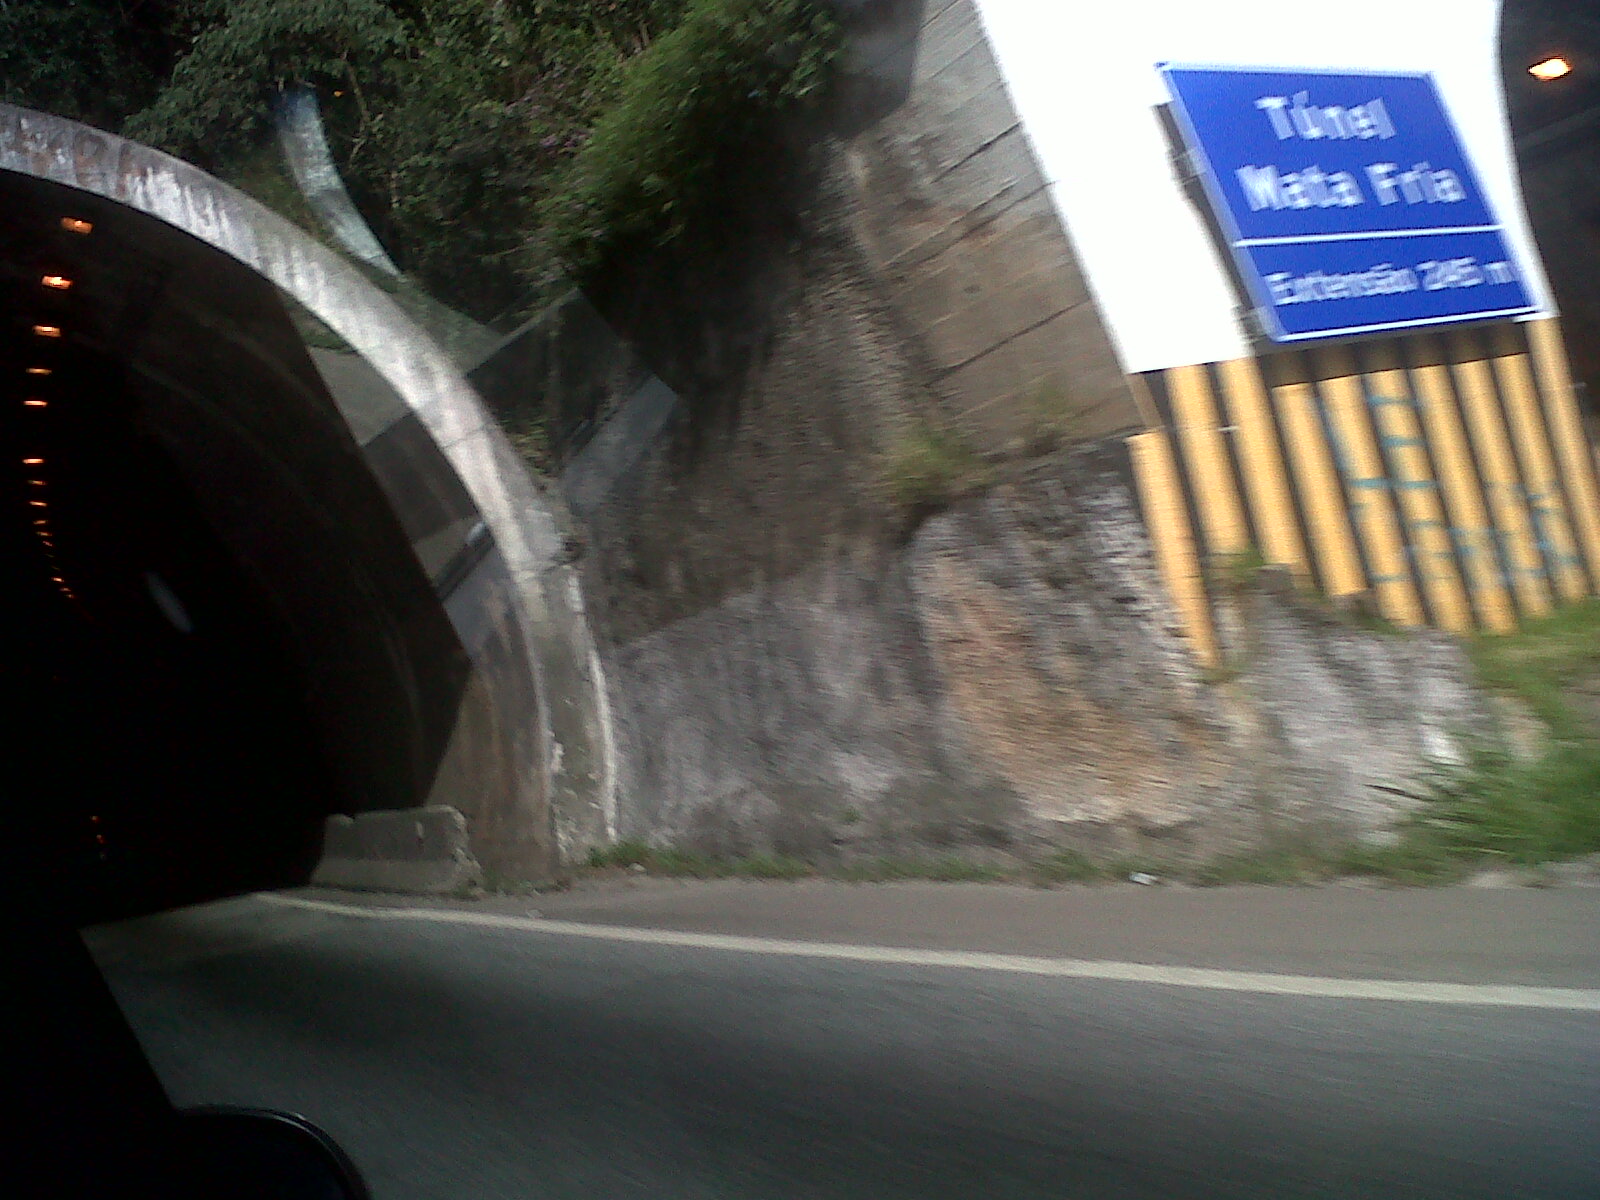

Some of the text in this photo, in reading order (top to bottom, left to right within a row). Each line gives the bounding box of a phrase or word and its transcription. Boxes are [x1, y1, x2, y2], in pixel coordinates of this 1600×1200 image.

[1253, 90, 1397, 140] Túnel
[1234, 165, 1365, 211] Mata
[1263, 262, 1420, 306] Extensão
[1485, 260, 1518, 285] m
